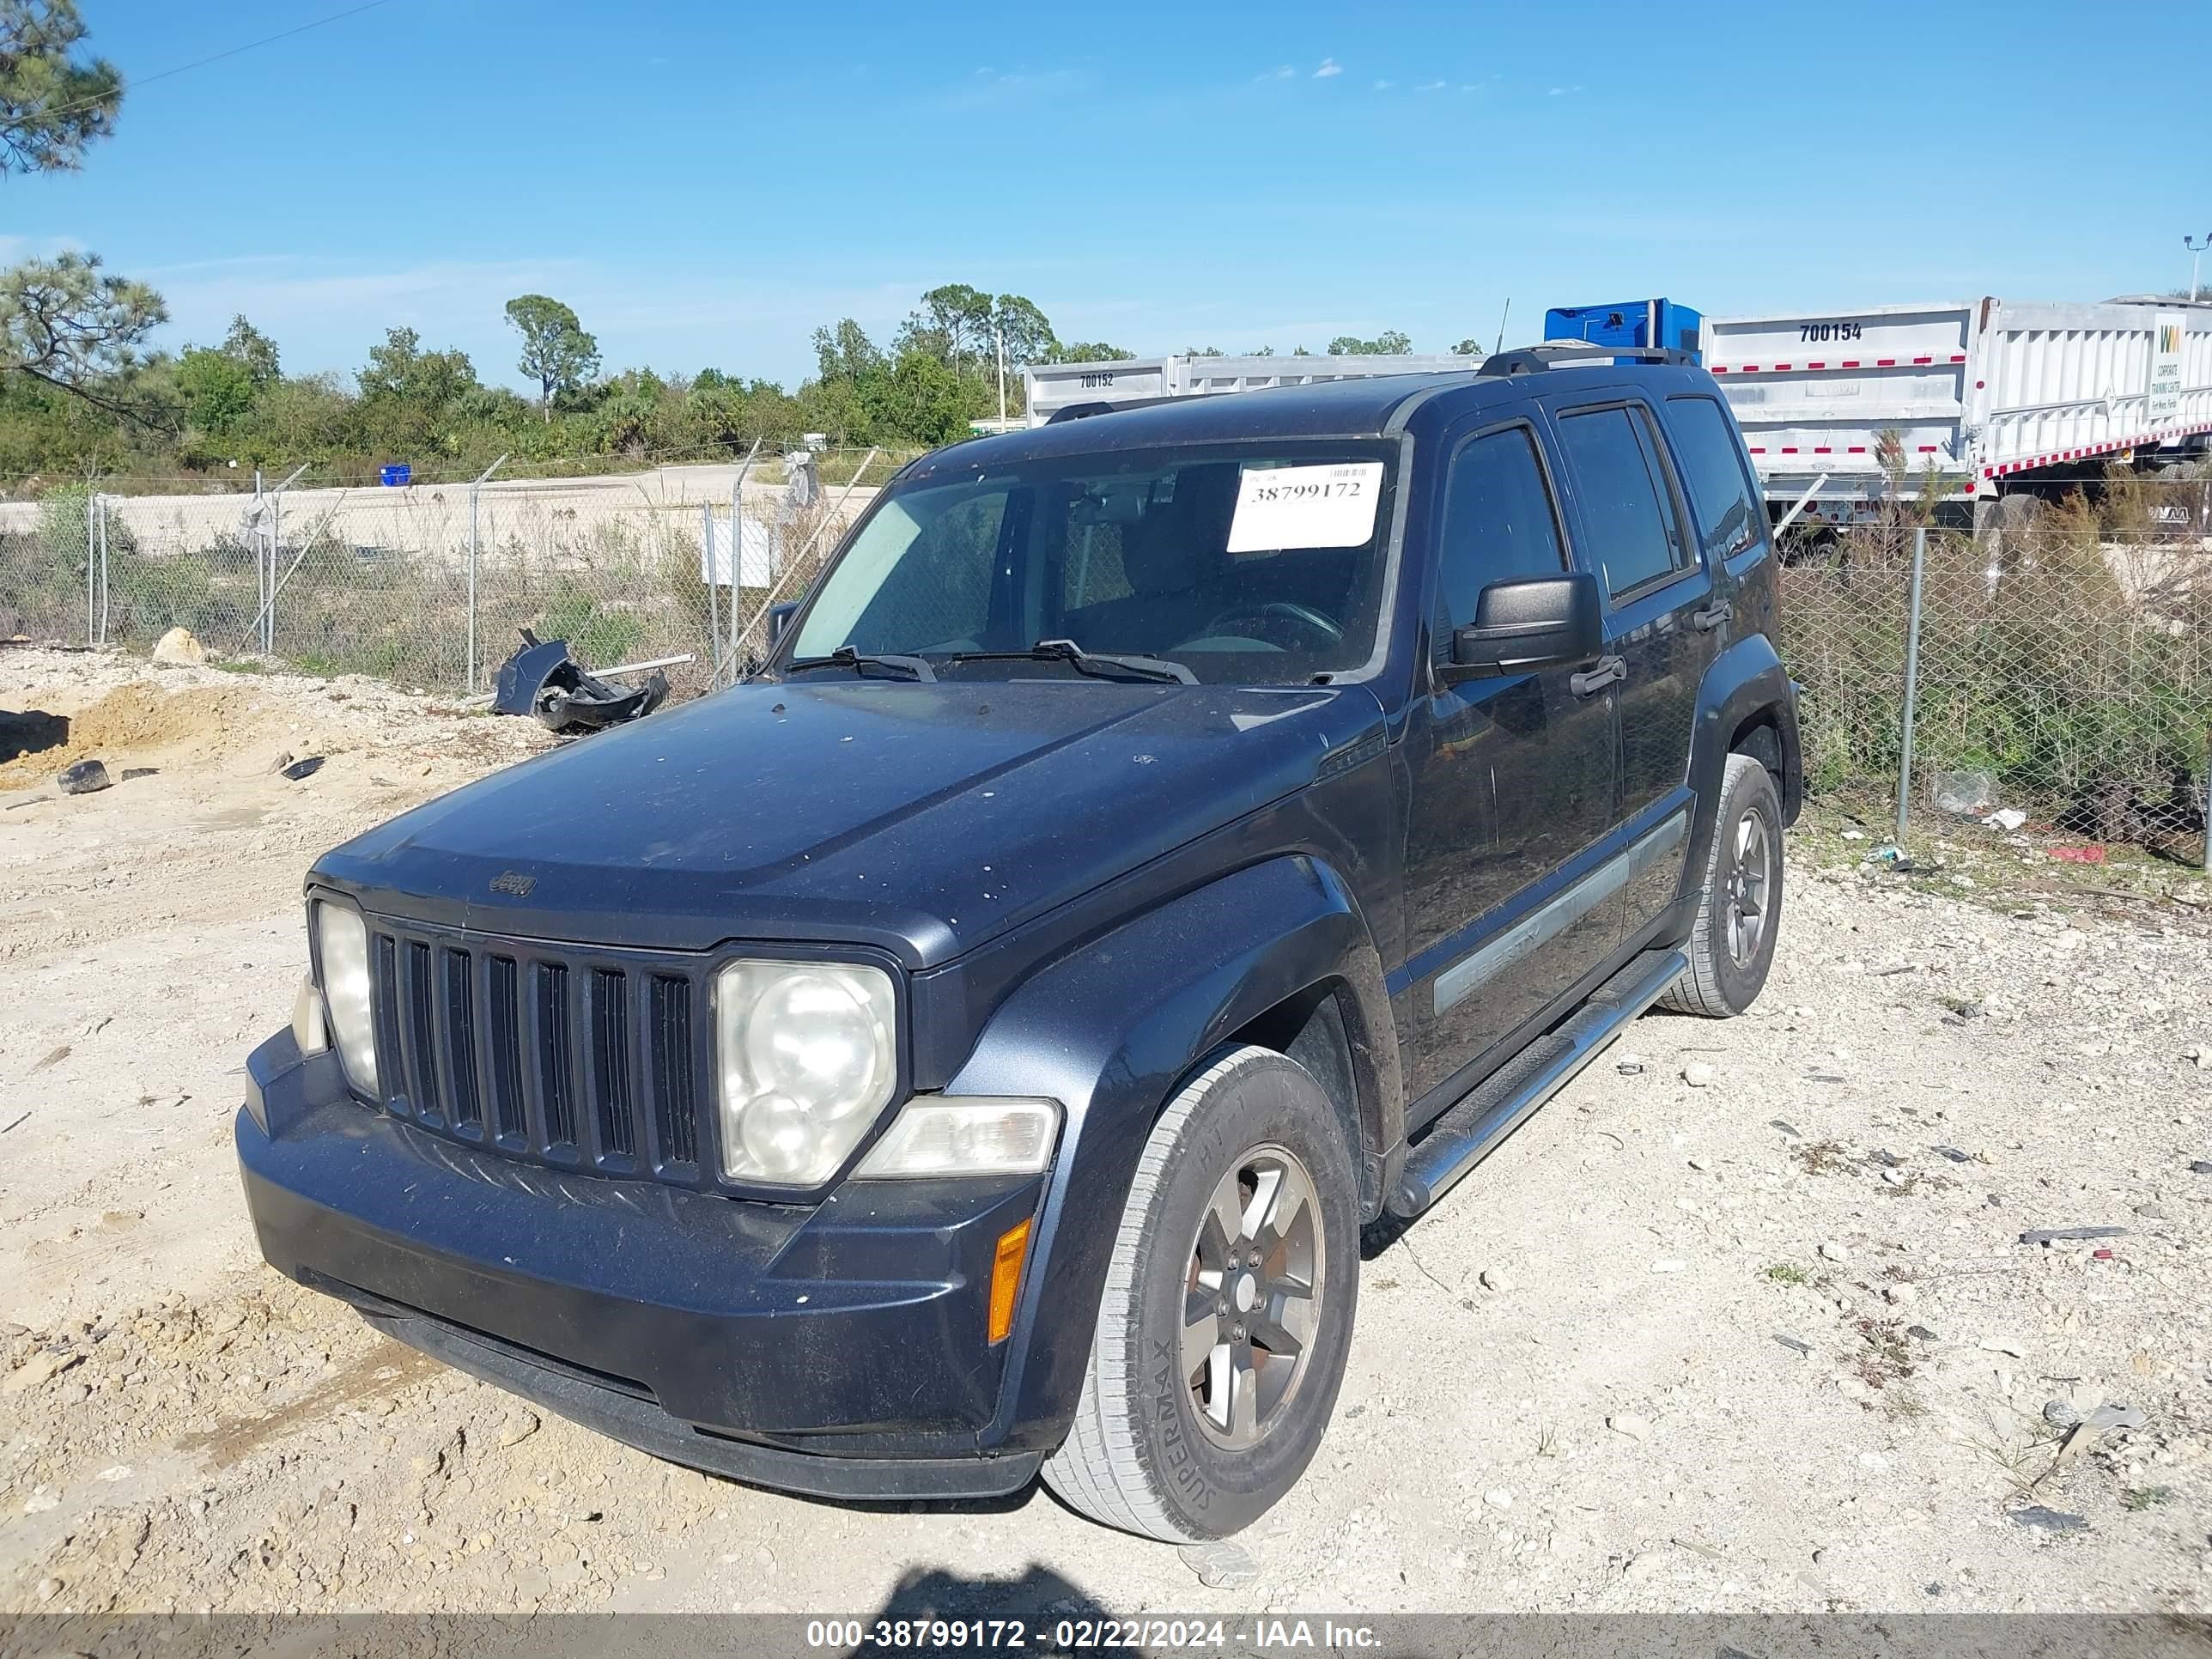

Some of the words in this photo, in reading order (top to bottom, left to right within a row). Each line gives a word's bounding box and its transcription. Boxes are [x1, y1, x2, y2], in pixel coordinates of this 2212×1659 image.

[1800, 323, 1862, 342] 700154
[2160, 325, 2180, 353] WM
[2157, 364, 2178, 377] CORPORATE
[1080, 374, 1114, 388] 700152
[2167, 380, 2181, 393] CENTER
[1251, 483, 1361, 502] 38799172
[489, 870, 537, 897] Jeep
[1153, 1339, 1217, 1511] SUPERMAX
